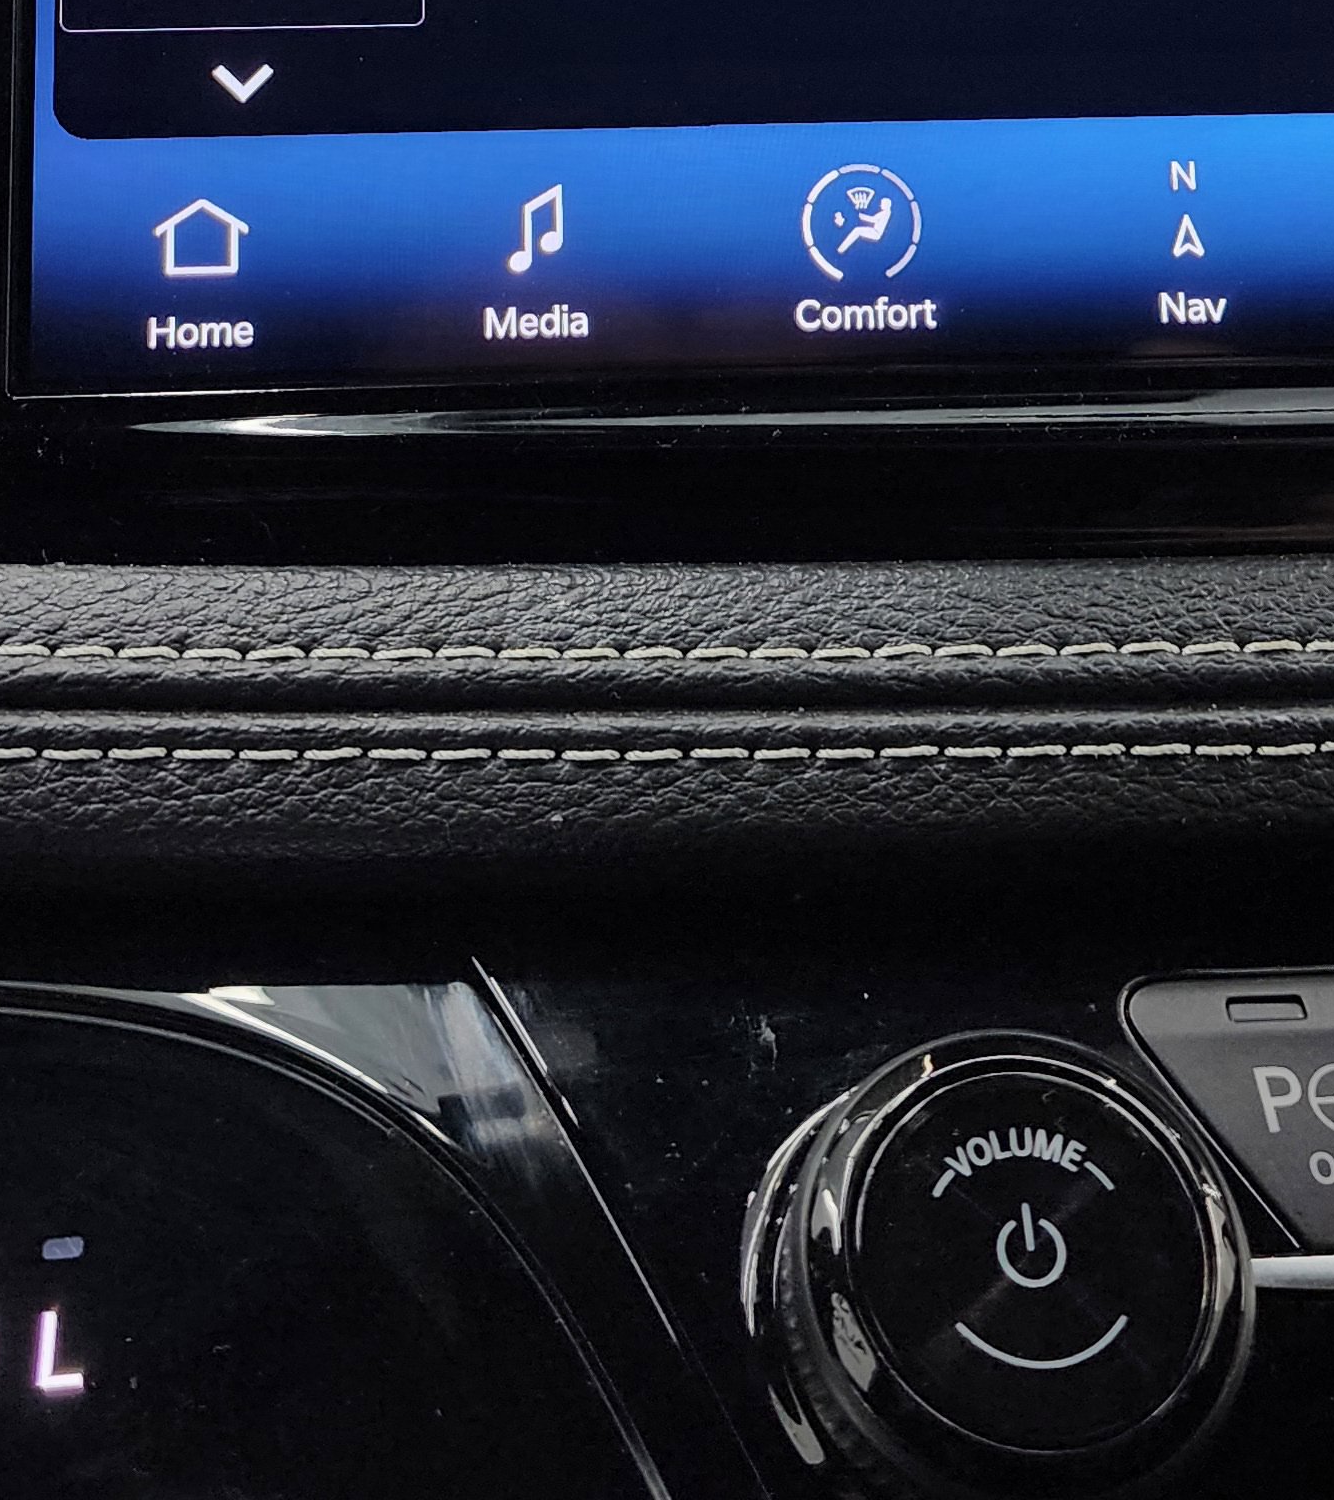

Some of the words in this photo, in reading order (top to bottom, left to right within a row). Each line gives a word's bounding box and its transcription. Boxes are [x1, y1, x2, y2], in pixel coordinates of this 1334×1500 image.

[483, 303, 590, 341] Media
[794, 295, 939, 333] Comfort
[1157, 290, 1228, 325] Nav
[147, 315, 255, 351] Home
[942, 1125, 1088, 1178] VOLUME
